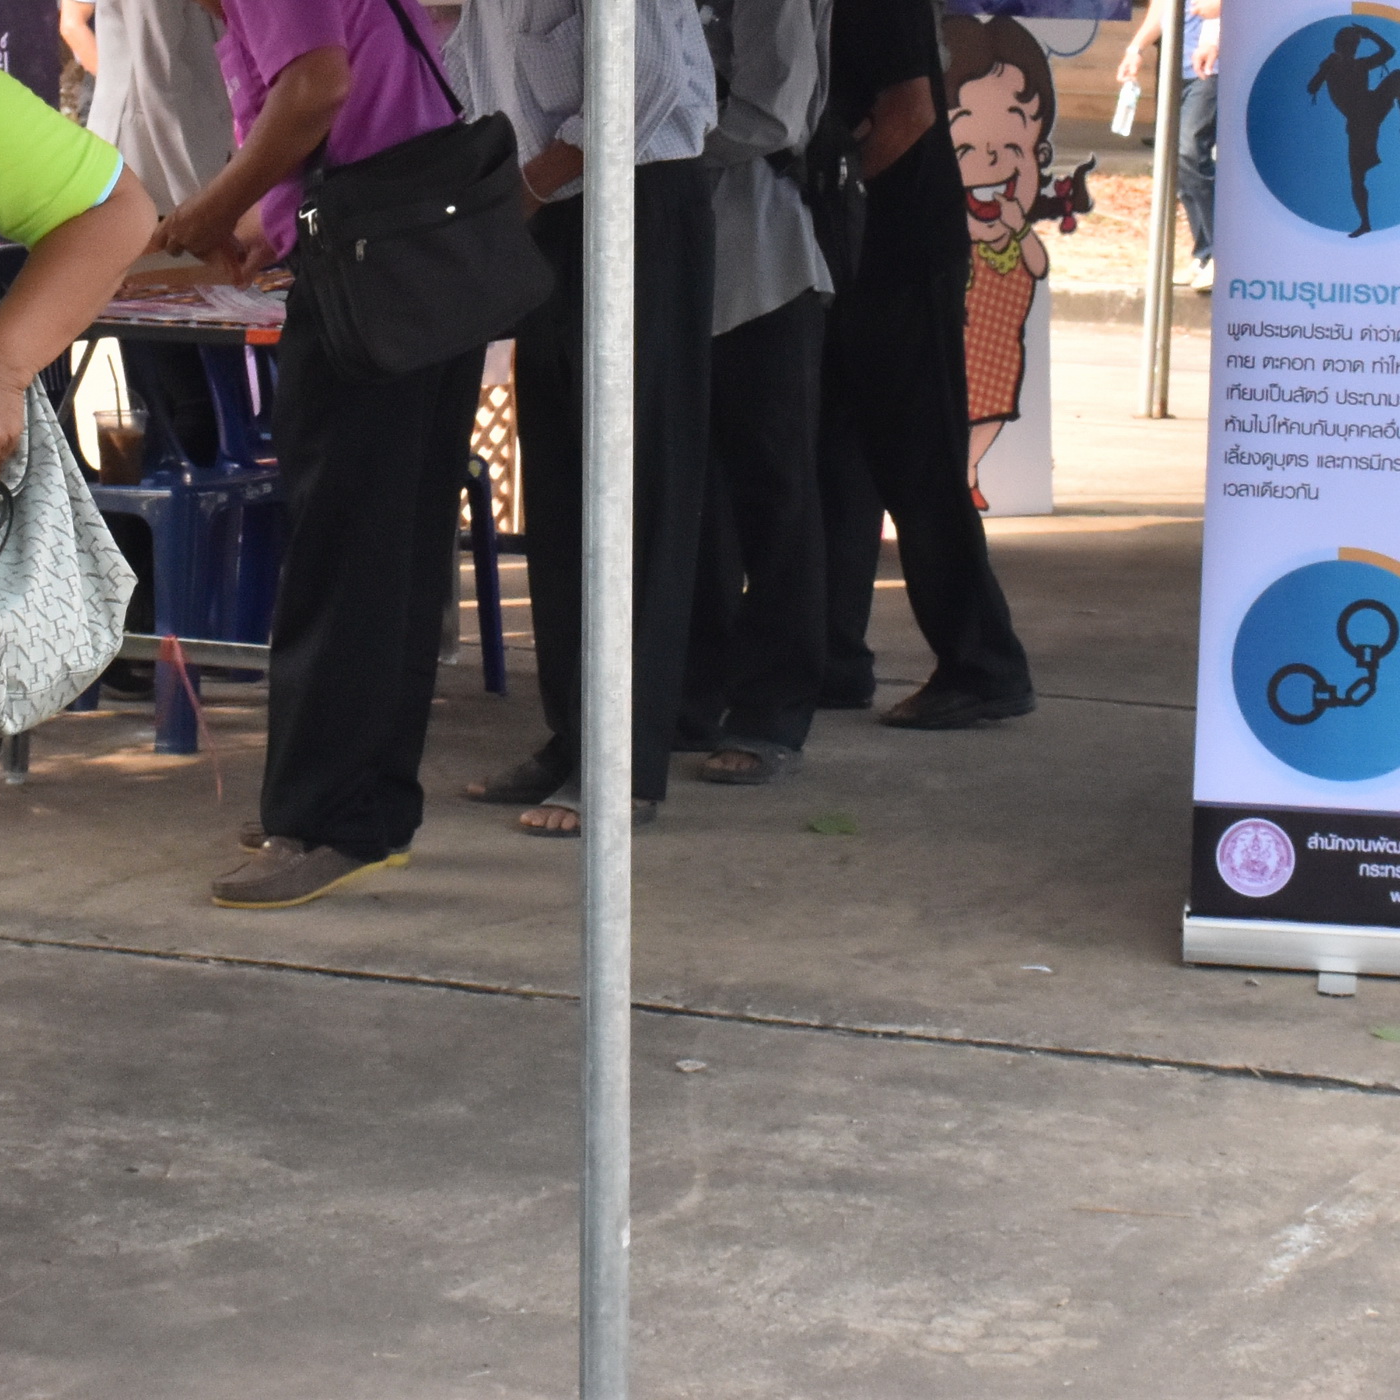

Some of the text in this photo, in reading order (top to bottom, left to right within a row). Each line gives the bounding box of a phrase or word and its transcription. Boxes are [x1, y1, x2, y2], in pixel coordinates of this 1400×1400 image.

[1226, 320, 1353, 342] พูดประชดประชัน
[1226, 353, 1256, 369] คาย
[1262, 355, 1316, 372] ตะคอก
[1322, 358, 1365, 374] ตวาด
[1226, 383, 1329, 404] เทียบเป็นสัตว์
[1223, 443, 1309, 471] เลี้ยงดูบุตร
[1222, 480, 1320, 500] เวลาเดียวกัน
